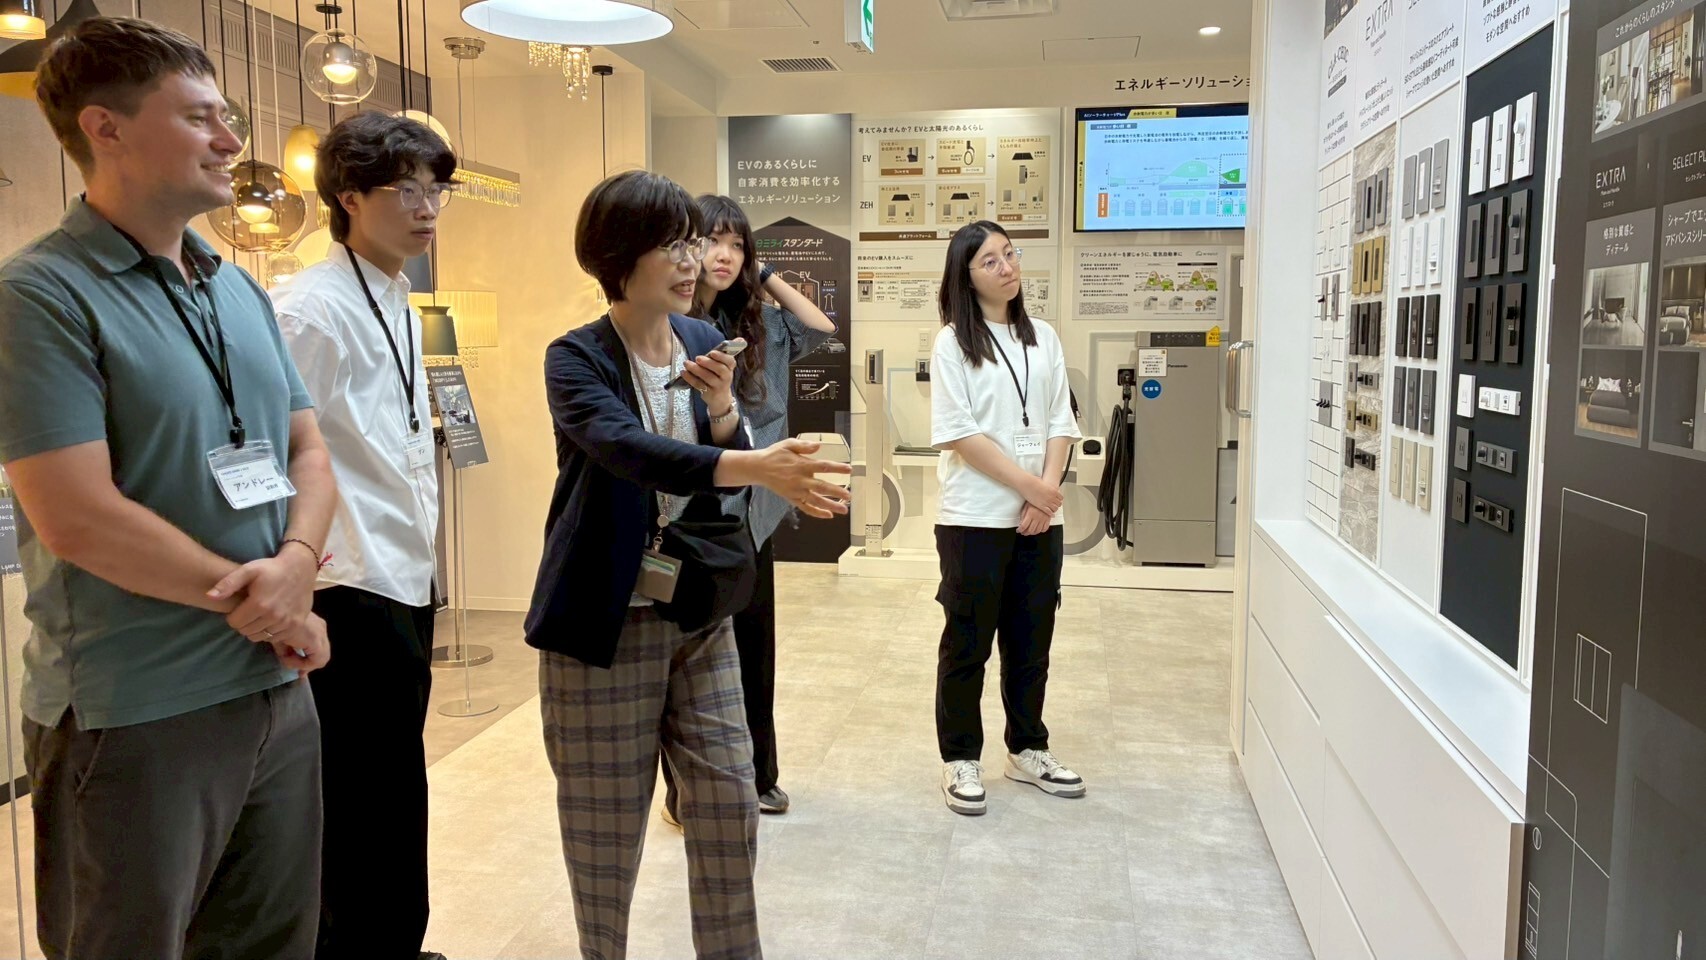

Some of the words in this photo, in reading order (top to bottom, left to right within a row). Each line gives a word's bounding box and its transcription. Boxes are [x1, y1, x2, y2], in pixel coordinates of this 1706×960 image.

[1615, 0, 1676, 38] これからのくらしのスタンダ
[737, 159, 817, 170] EVのあるくらしに
[862, 154, 872, 163] EV
[1672, 152, 1698, 171] SELECT
[738, 176, 840, 188] 自家消費を効率化する
[1596, 166, 1626, 189] EXTRA
[738, 194, 841, 205] エネルギーソリューション
[859, 201, 874, 209] ZEH
[1603, 223, 1634, 240] 格別な質感と
[1606, 243, 1629, 256] ディテール
[799, 271, 811, 279] EV
[233, 477, 274, 492] アンドレー
